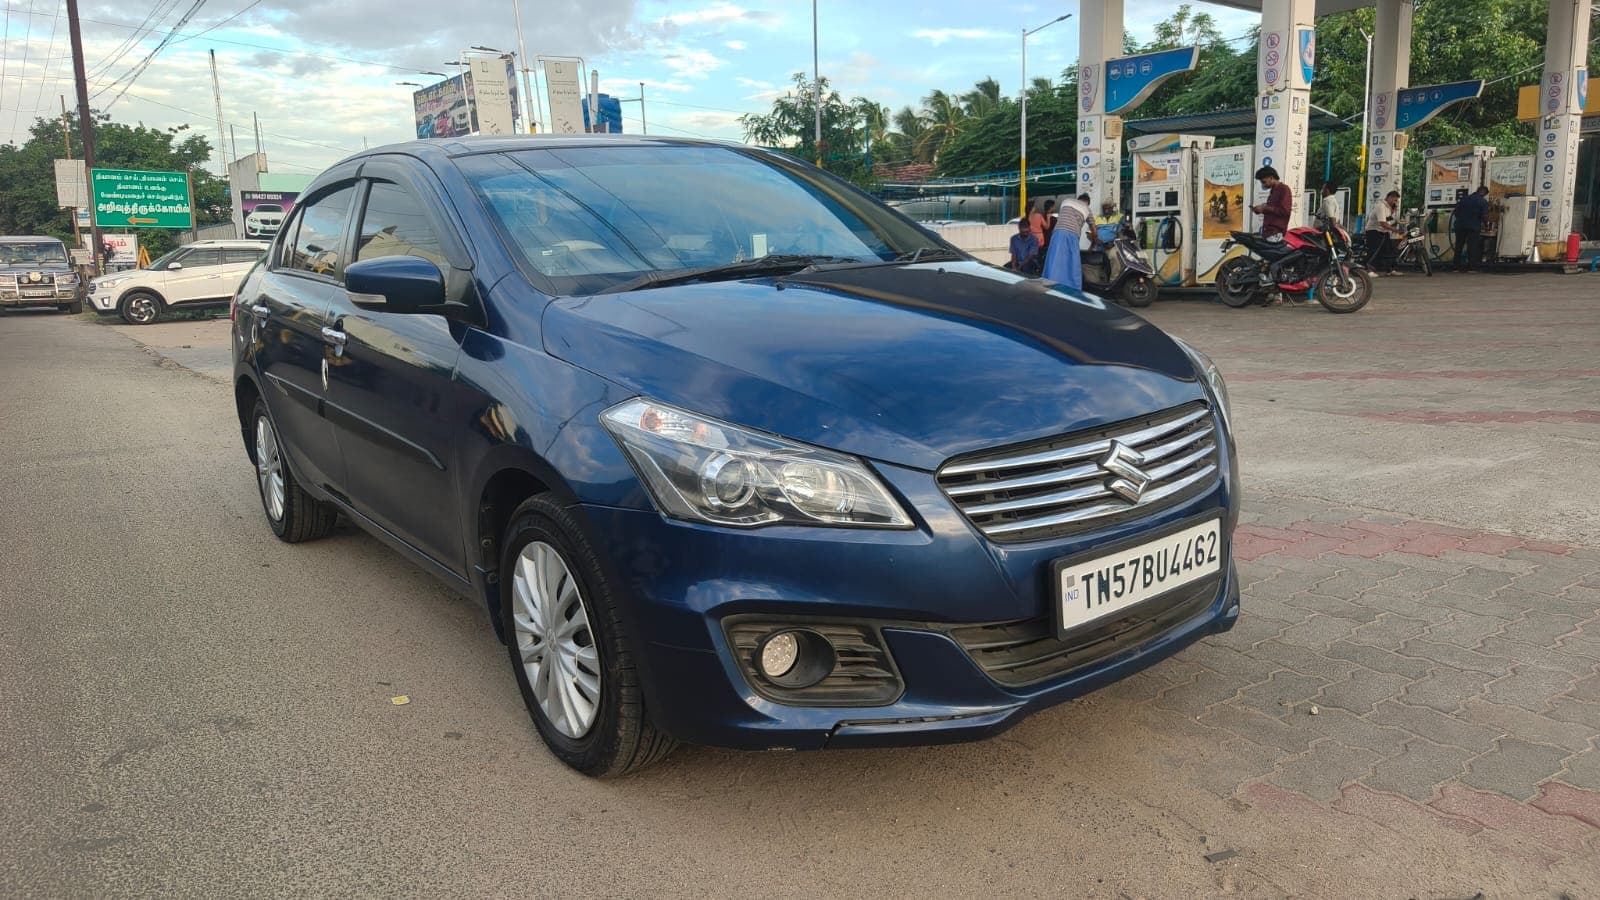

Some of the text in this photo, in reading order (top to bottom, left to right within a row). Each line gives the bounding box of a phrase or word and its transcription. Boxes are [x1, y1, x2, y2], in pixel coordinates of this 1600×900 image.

[1112, 89, 1117, 101] 1
[1403, 112, 1409, 122] 3
[97, 201, 190, 215] அறிவுத்திருக்கோயில்
[1081, 530, 1217, 609] TN57BU4462
[1064, 588, 1079, 602] IND
